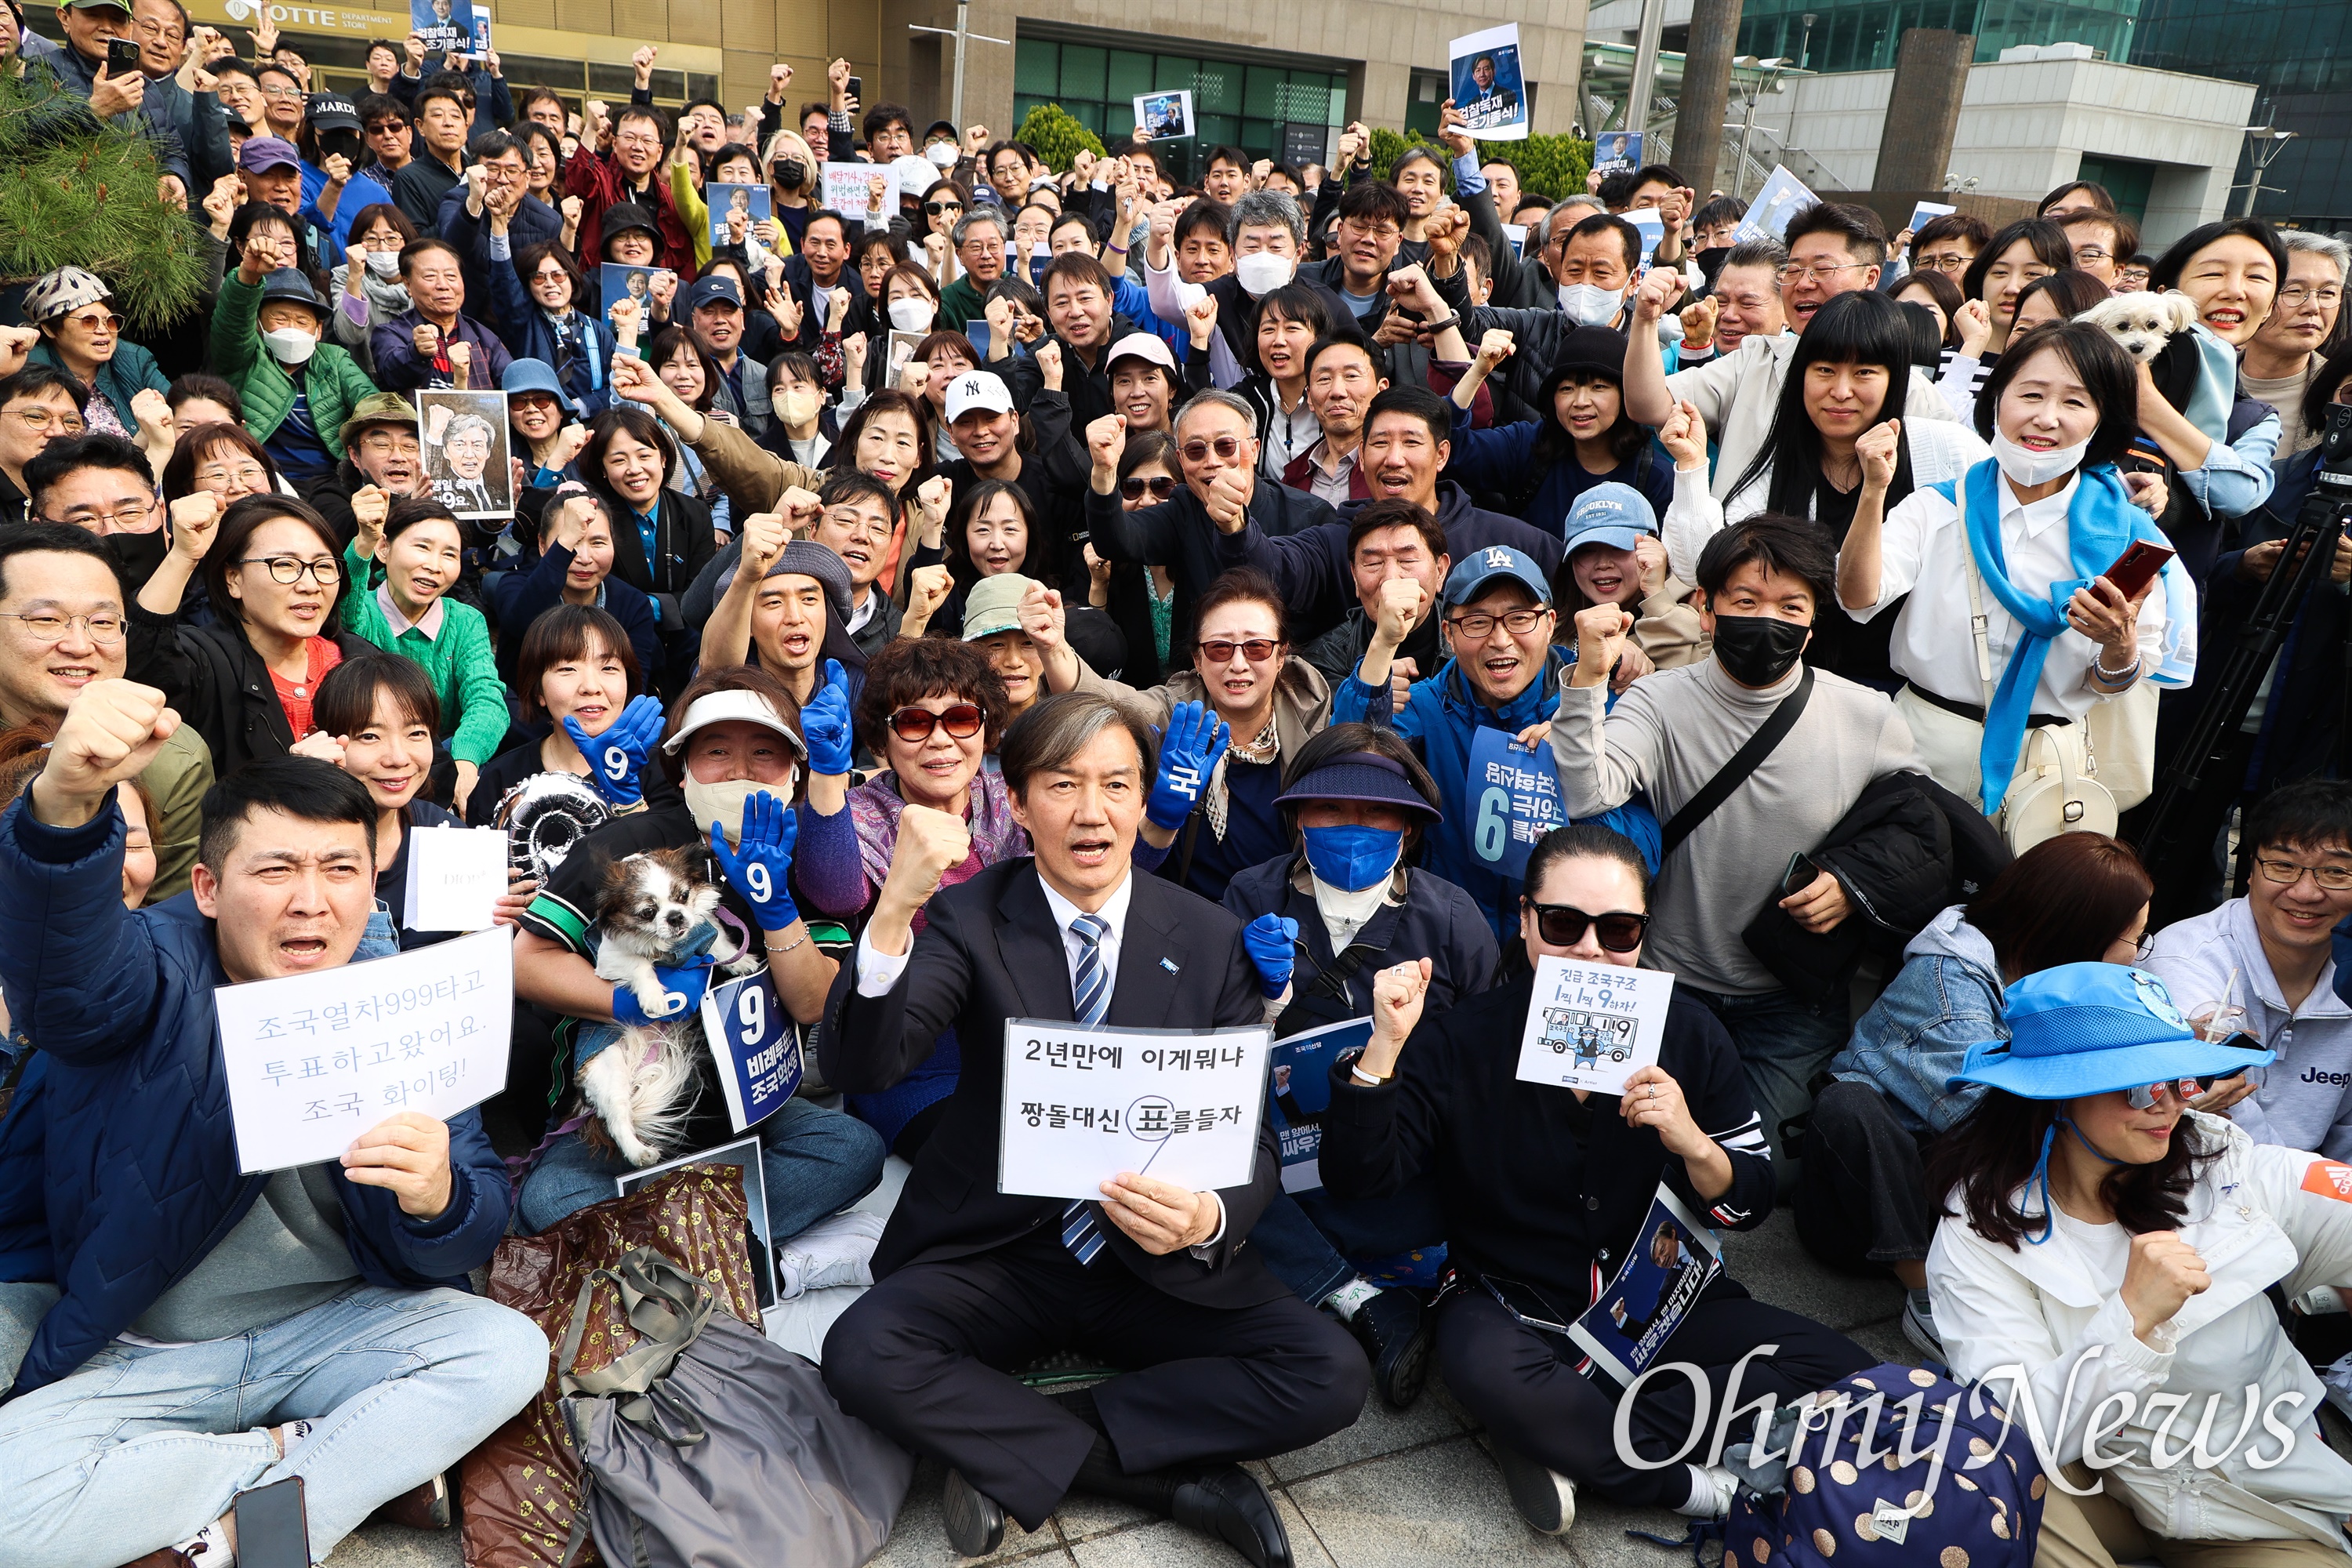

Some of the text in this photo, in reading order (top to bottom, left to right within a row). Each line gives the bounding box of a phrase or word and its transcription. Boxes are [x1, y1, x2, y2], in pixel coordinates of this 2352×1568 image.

[341, 12, 392, 24] DEPARTMENT
[343, 20, 367, 30] STORE
[426, 37, 470, 49] 조기종식!
[316, 101, 357, 115] MARDI
[1467, 103, 1519, 129] 조기종식!
[1576, 500, 1623, 520] BROOKLYN
[1485, 546, 1514, 568] LA
[604, 746, 629, 780] 9
[1168, 765, 1201, 801] 국
[746, 862, 772, 903] 9
[1559, 968, 1638, 992] 긴급 조국구조
[255, 970, 485, 1040] 조국열차999타고
[739, 985, 766, 1046] 9
[261, 1015, 487, 1087] 투표하고왔어요.
[1025, 1039, 1244, 1072] 2년만에 이게뭐냐
[302, 1058, 466, 1122] 조국 화이팅!
[751, 1047, 798, 1105] 조국혁신당
[2300, 1067, 2351, 1089] Jeep
[1020, 1102, 1242, 1136] 짱돌대신 표를들자
[1279, 1130, 1290, 1141] 맨
[1630, 1345, 1639, 1359] 맨
[1661, 1305, 1669, 1319] 맨
[1668, 1256, 1697, 1306] 마지막까지
[1633, 1261, 1704, 1369] 싸우겠습니다!
